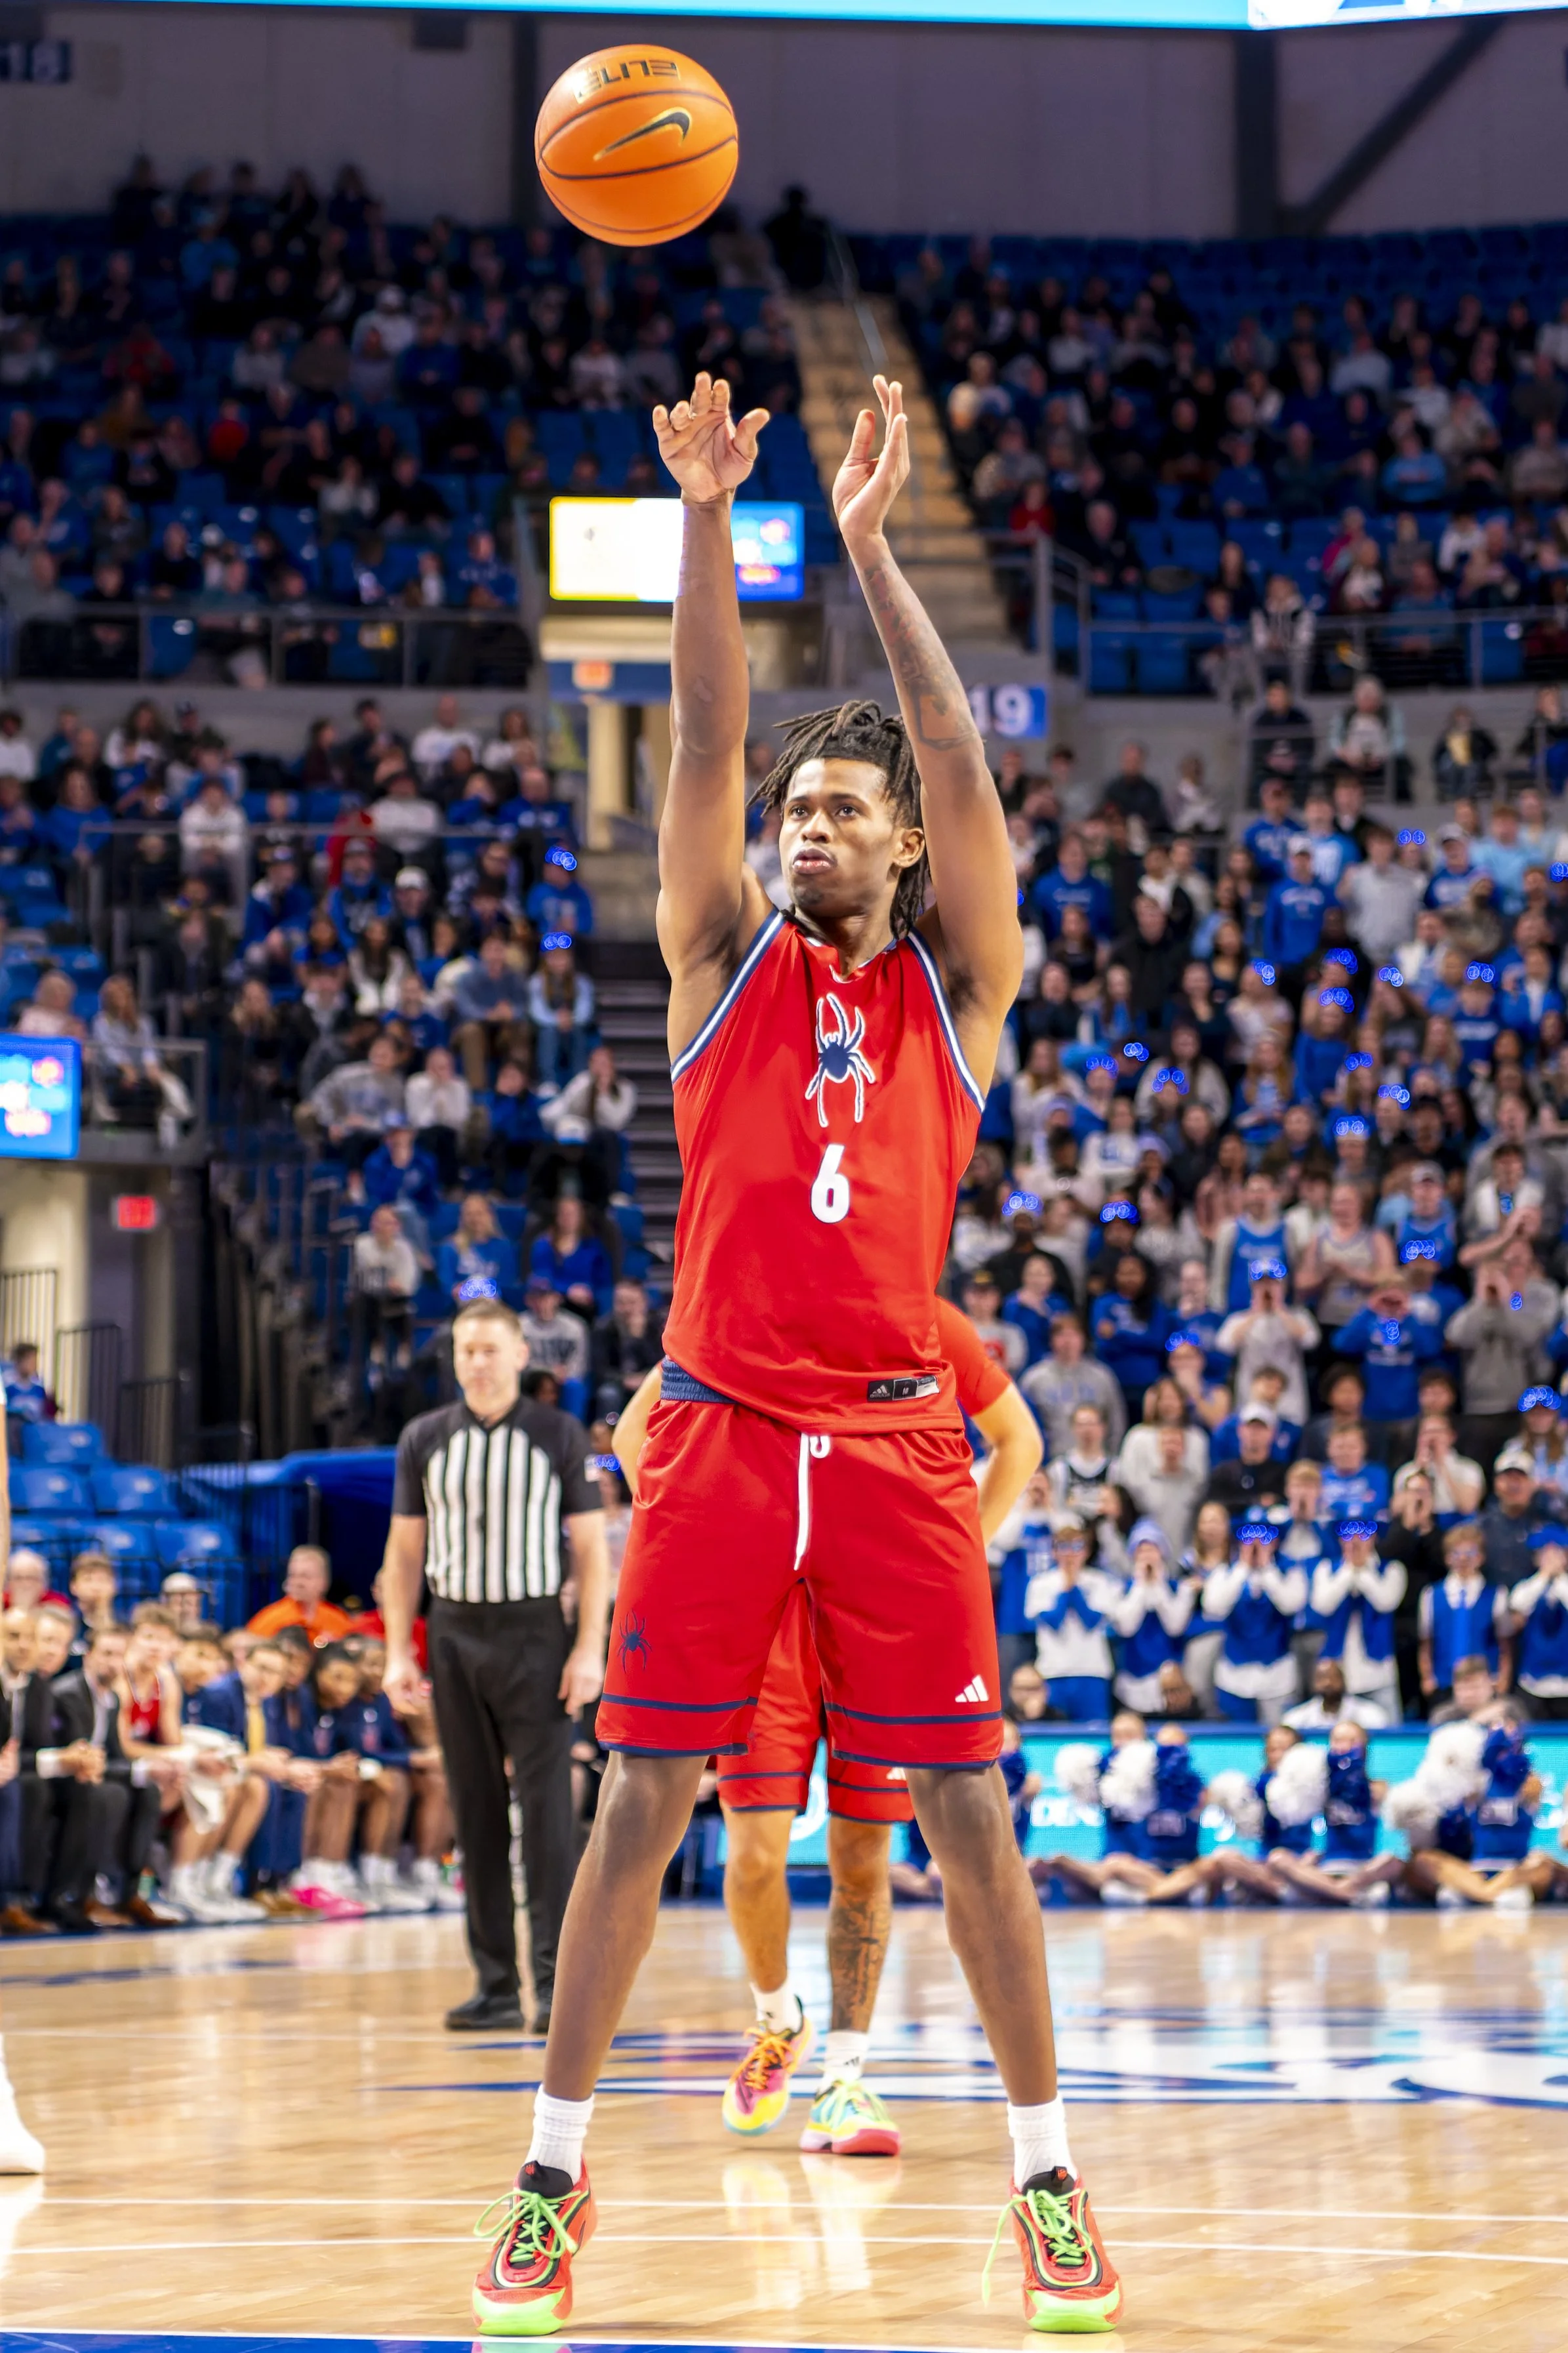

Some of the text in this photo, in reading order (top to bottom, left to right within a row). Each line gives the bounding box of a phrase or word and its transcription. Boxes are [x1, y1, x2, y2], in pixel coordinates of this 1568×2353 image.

[573, 59, 681, 103] ELITE
[969, 683, 1032, 737] 19
[810, 1143, 851, 1224] 6
